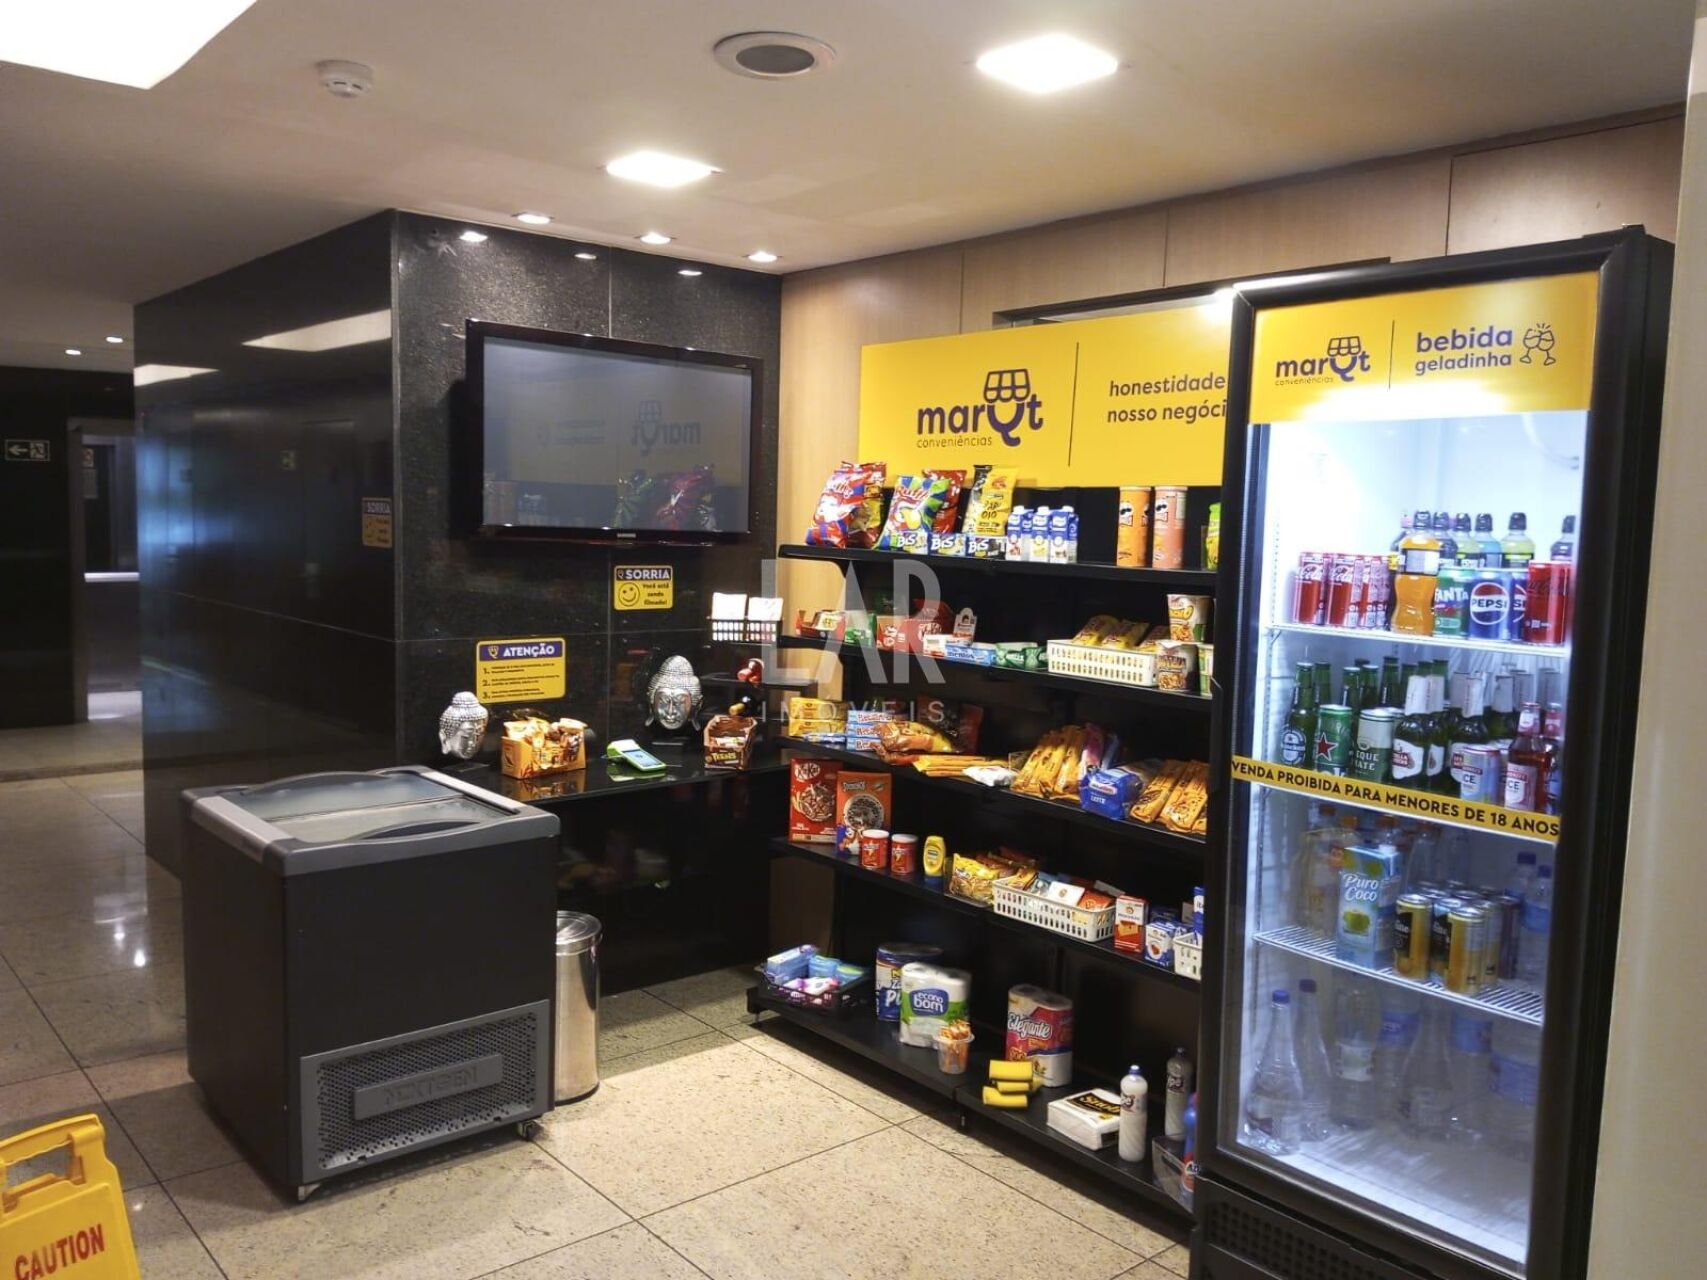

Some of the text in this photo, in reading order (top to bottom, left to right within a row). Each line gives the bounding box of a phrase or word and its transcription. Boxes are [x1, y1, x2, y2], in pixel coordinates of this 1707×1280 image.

[1416, 325, 1513, 352] bebida
[1415, 352, 1512, 376] geladinha
[1110, 372, 1226, 397] honestidade
[1107, 399, 1227, 424] nosso negóci
[917, 436, 992, 448] conveniências
[625, 569, 670, 579] SORRIA
[1471, 598, 1508, 609] PEPSI
[503, 643, 555, 657] ATENÇÃO
[1231, 760, 1274, 781] VENDA
[1277, 771, 1341, 794] PROIBIDA
[1345, 784, 1381, 802] PARA
[1386, 792, 1459, 817] MENORES
[1464, 807, 1485, 822] DE
[1490, 812, 1507, 826] 18
[1511, 817, 1559, 836] ANOS
[1343, 873, 1379, 889] Puro
[1344, 887, 1377, 902] Coco
[913, 994, 943, 1013] bom
[918, 992, 943, 1003] econo
[1007, 1012, 1051, 1039] Elegante
[14, 1223, 105, 1280] CAUTION
